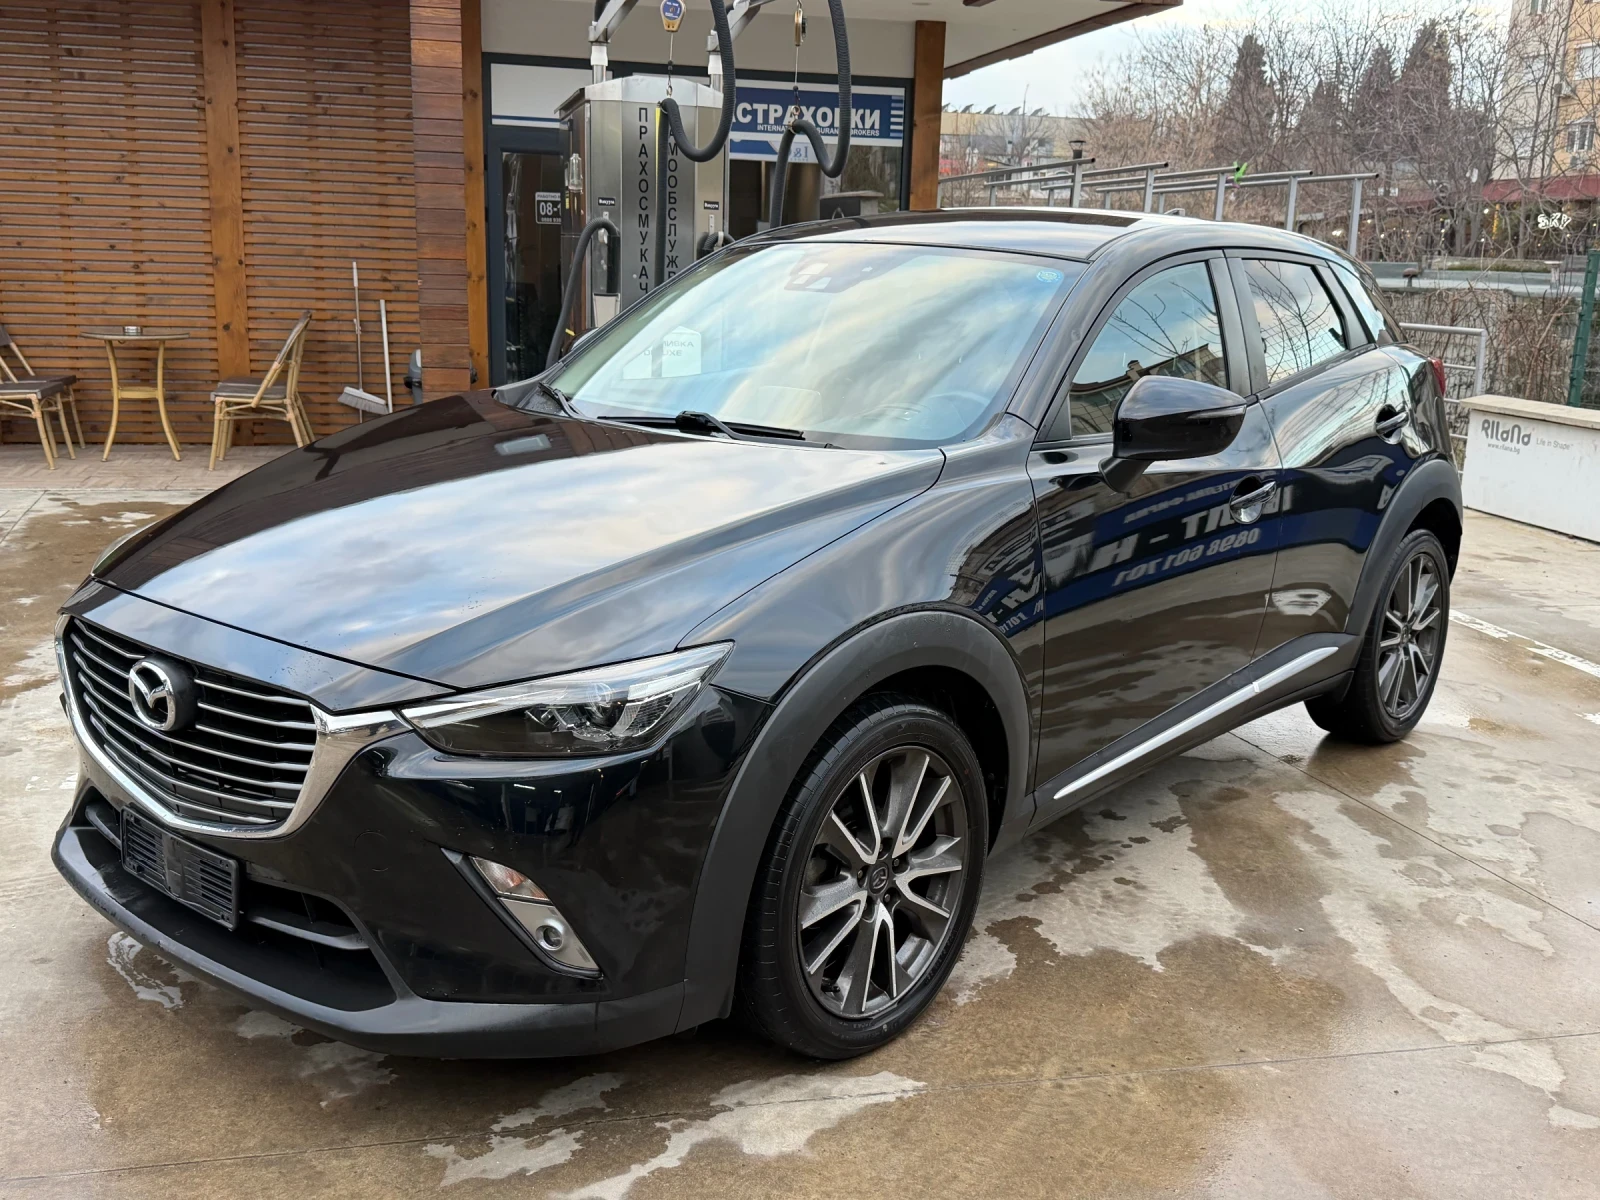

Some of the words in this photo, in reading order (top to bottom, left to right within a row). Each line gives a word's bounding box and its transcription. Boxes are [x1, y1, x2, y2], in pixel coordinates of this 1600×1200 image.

[731, 102, 881, 130] СТРАХОКИ
[638, 107, 649, 294] ПРАХОСМУКАЧ
[666, 126, 679, 279] МООБСЛУЖ
